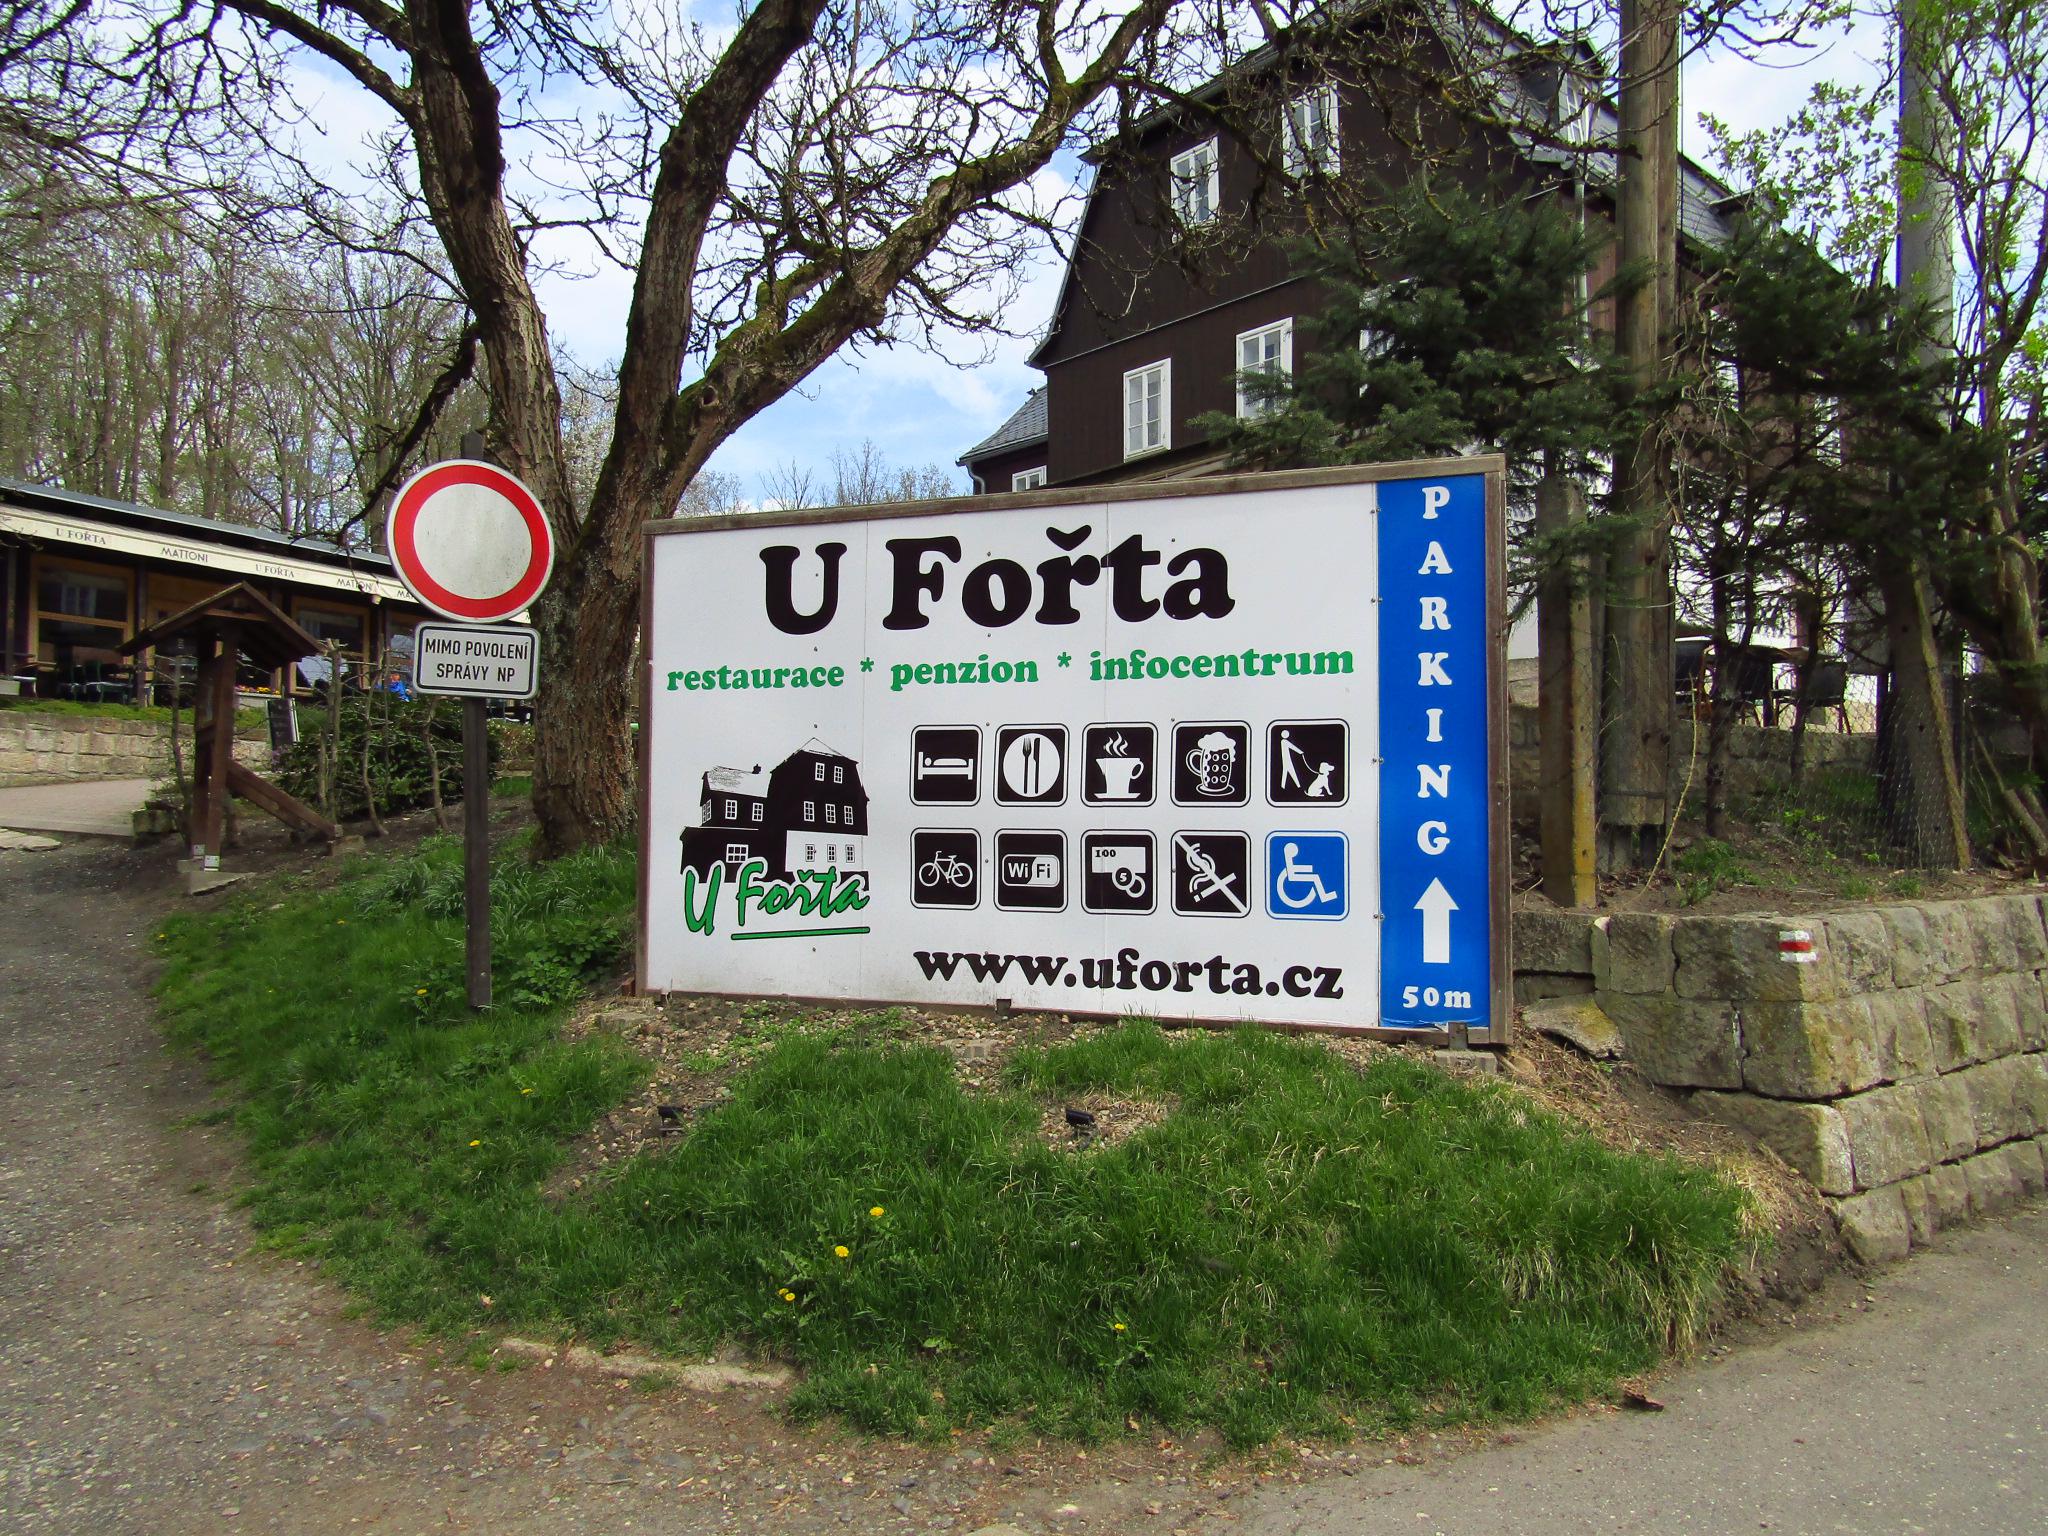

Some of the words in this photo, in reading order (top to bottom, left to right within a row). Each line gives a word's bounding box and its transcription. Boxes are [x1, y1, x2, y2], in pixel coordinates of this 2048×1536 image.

[56, 527, 65, 538] U
[161, 547, 209, 563] MATTONI
[255, 563, 263, 572] U
[759, 542, 848, 635] U
[882, 524, 1236, 630] Fořta
[425, 638, 461, 655] MIMO
[465, 641, 529, 660] POVOLENÍ
[436, 661, 489, 681] SPRÁVY
[497, 667, 516, 682] NP
[666, 665, 845, 691] restaurace
[890, 653, 1039, 692] penzion
[1089, 648, 1354, 681] infocentrum
[1417, 485, 1453, 856] PARKING
[1094, 849, 1117, 858] 100
[1119, 871, 1128, 883] 5
[683, 864, 722, 936] U
[736, 860, 871, 928] Fořta
[913, 947, 1344, 999] www.uforta.cz
